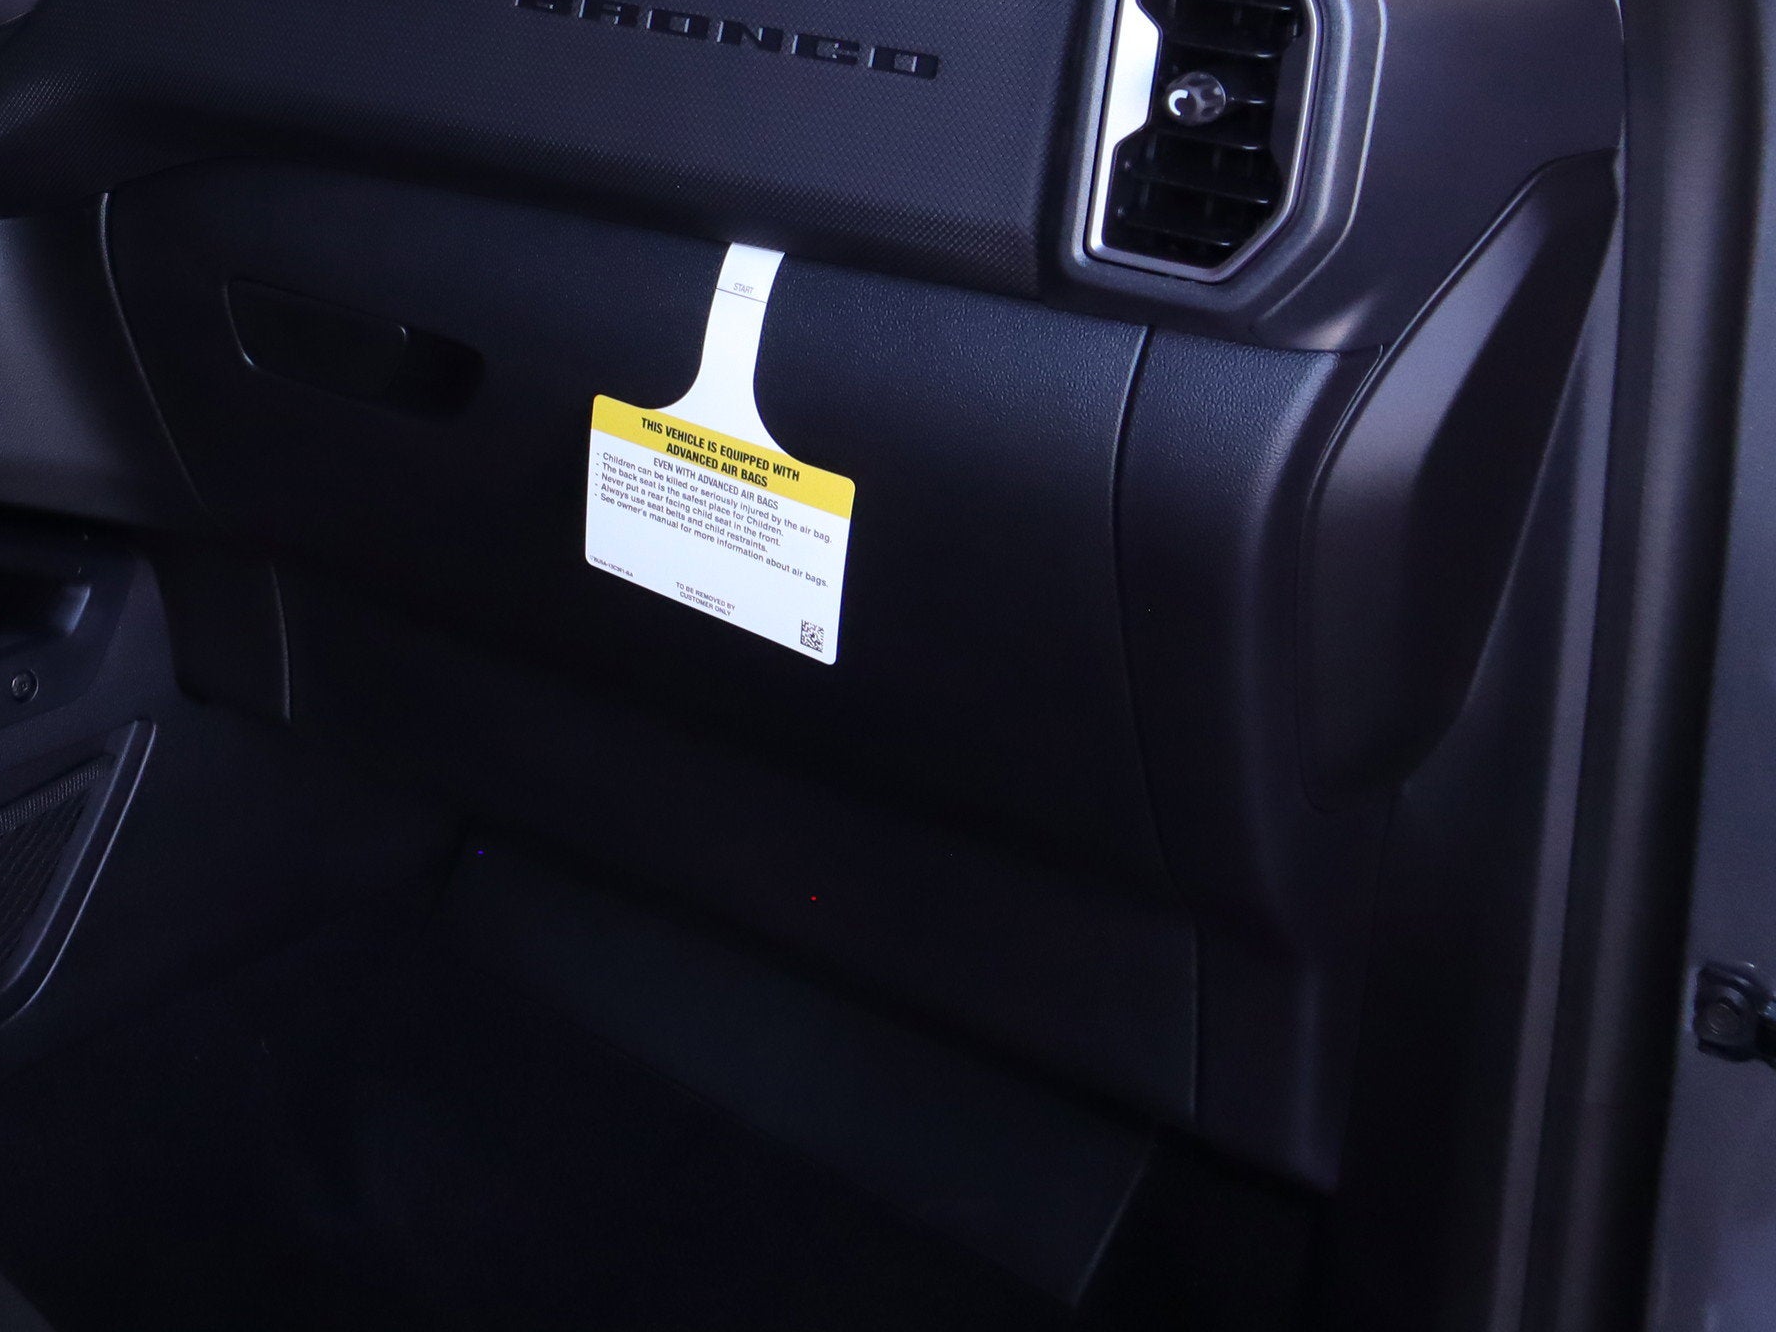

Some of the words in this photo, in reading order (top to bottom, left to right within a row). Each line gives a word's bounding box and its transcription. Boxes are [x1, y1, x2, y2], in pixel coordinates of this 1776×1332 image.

[733, 282, 754, 295] START
[641, 417, 663, 434] THIS
[665, 425, 705, 449] VEHICLE
[707, 440, 717, 453] IS
[720, 445, 769, 471] EQUIPPED
[773, 463, 800, 482] WITH
[666, 443, 718, 470] ADVANCED
[721, 462, 738, 477] AIR
[741, 469, 768, 488] BAGS
[601, 473, 624, 486] Never
[626, 482, 639, 494] put
[647, 491, 664, 502] rear
[665, 496, 691, 514] facing
[692, 505, 713, 521] child
[714, 516, 732, 528] seat
[734, 522, 742, 532] in
[743, 524, 757, 538] the
[758, 532, 781, 547] front.
[602, 462, 617, 474] The
[619, 468, 637, 482] back
[639, 477, 656, 489] seat
[658, 483, 665, 492] is
[667, 485, 681, 497] the
[682, 491, 708, 508] safest
[709, 502, 731, 517] place
[733, 511, 744, 521] for
[746, 515, 784, 537] Children.
[603, 452, 636, 470] Children
[638, 466, 652, 477] can
[654, 470, 664, 481] be
[666, 474, 688, 490] killed
[690, 485, 699, 493] or
[701, 489, 738, 509] seriously
[740, 502, 769, 520] injured
[771, 512, 782, 526] by
[784, 518, 798, 530] the
[800, 525, 811, 535] air
[814, 530, 832, 544] bag.
[653, 457, 674, 472] EVEN
[675, 464, 696, 480] WITH
[697, 473, 739, 496] ADVANCED
[740, 490, 755, 502] AIR
[757, 495, 779, 510] BAGS
[600, 493, 615, 505] See
[616, 500, 647, 517] owner's
[649, 512, 679, 529] manual
[680, 523, 692, 534] for
[694, 529, 715, 543] more
[716, 536, 764, 562] information
[766, 556, 790, 572] about
[792, 567, 803, 578] air
[805, 571, 828, 588] bags.
[601, 483, 629, 500] Always
[631, 496, 645, 506] use
[647, 501, 664, 513] seat
[666, 507, 685, 521] belts
[687, 516, 703, 528] and
[705, 522, 725, 536] child
[726, 529, 768, 553] restraints.
[675, 581, 685, 590] TO
[686, 585, 694, 594] BE
[695, 589, 725, 607] REMOVED
[726, 602, 735, 611] BY
[679, 591, 714, 610] CUSTOMER
[714, 606, 731, 617] ONLY
